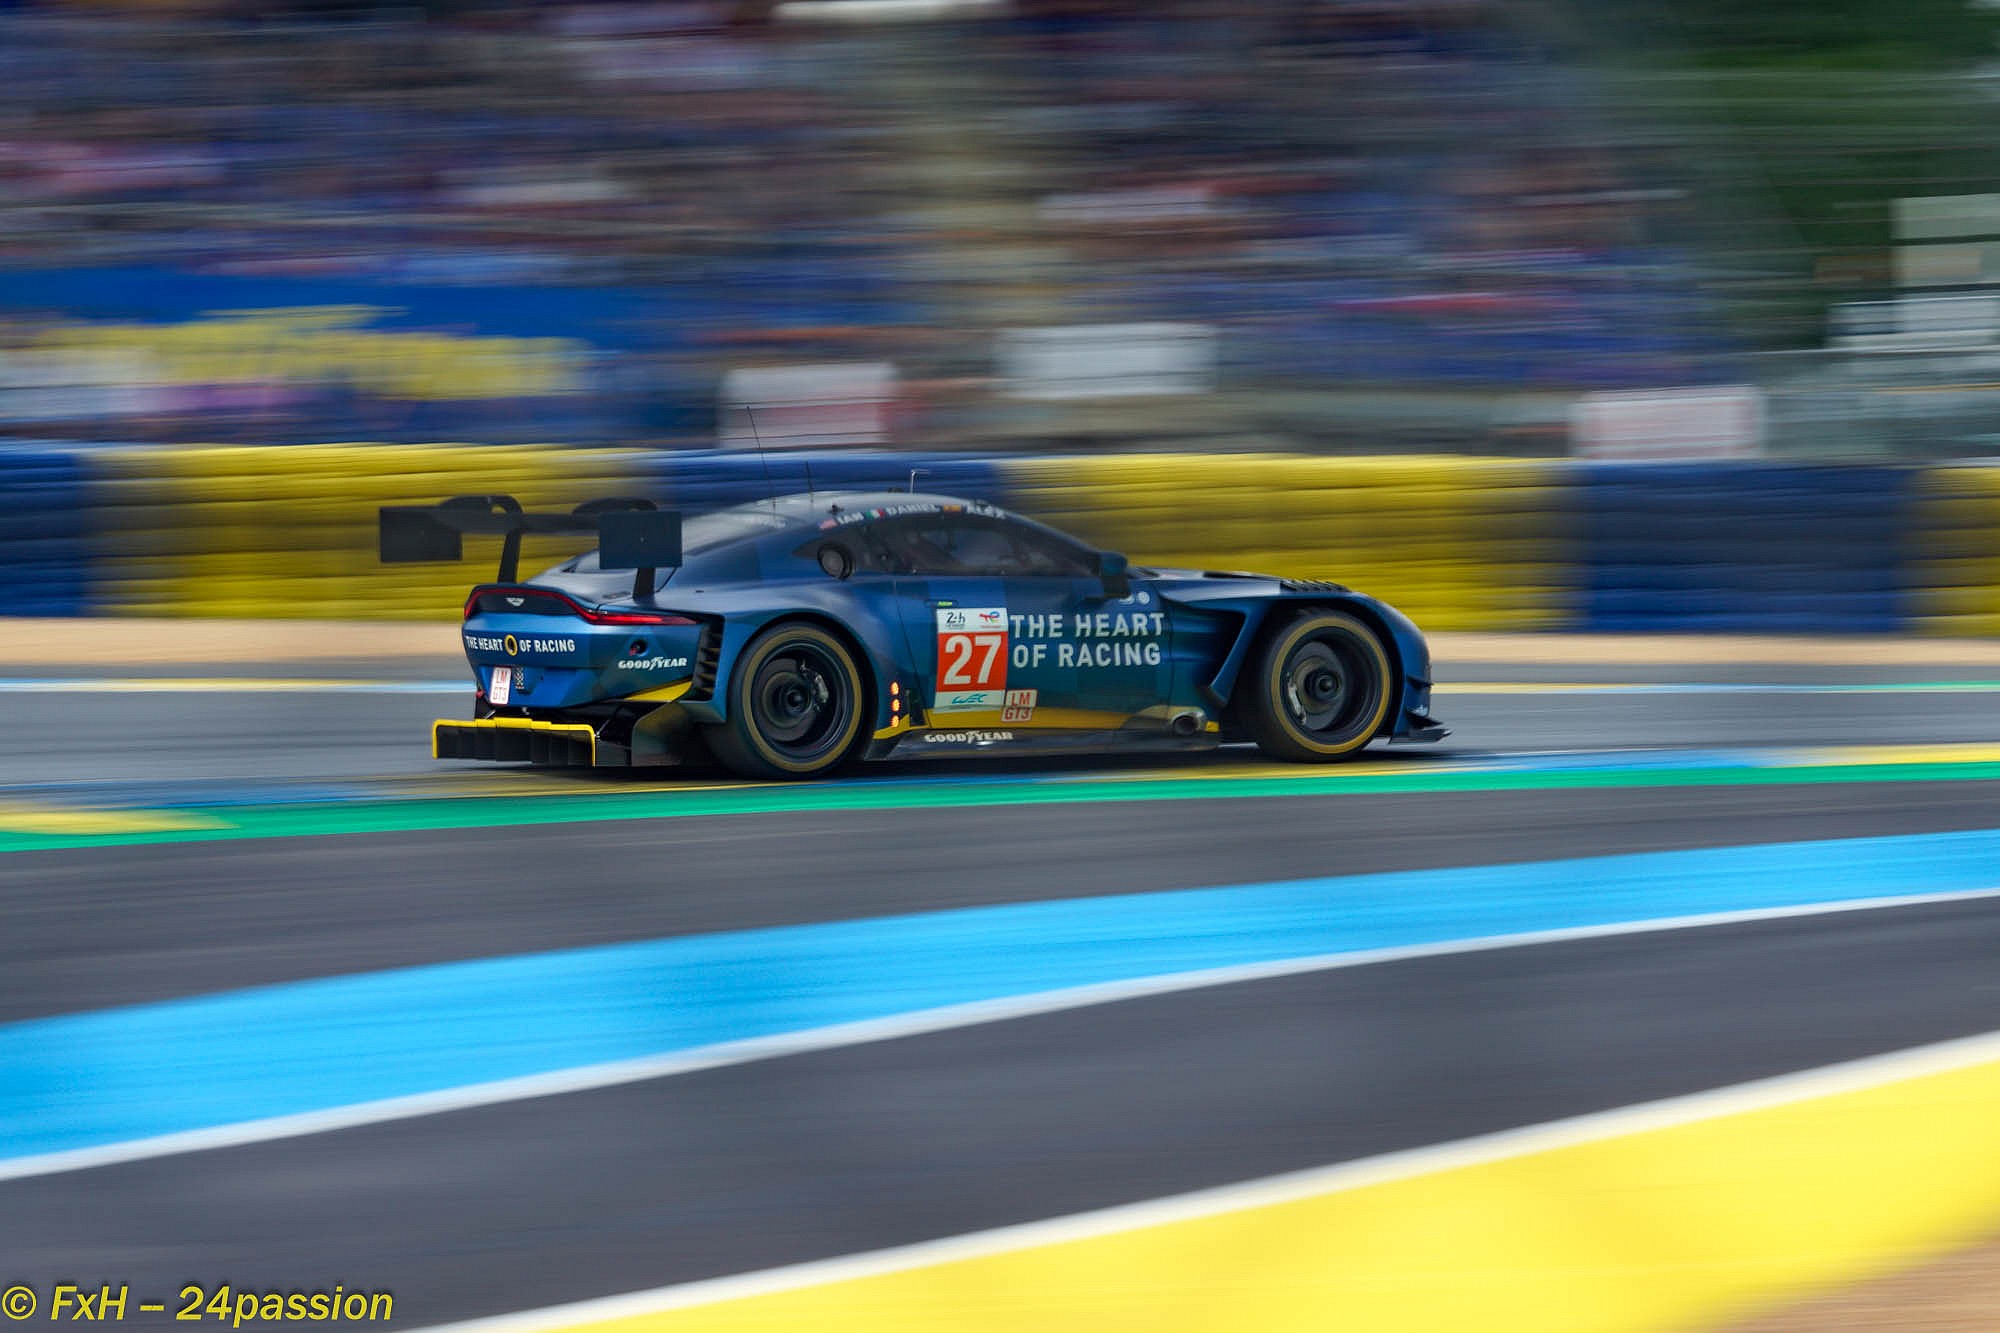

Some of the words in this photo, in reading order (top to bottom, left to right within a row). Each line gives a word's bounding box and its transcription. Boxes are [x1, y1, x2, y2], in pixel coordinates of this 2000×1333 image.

[886, 503, 940, 516] DANIEL
[1010, 614, 1064, 639] THE
[1076, 612, 1165, 637] HEART
[465, 636, 478, 650] THE
[479, 638, 503, 651] HEART
[520, 639, 531, 652] OF
[534, 639, 576, 653] RACING
[943, 634, 1002, 685] 27
[1013, 644, 1047, 668] OF
[1058, 641, 1161, 667] RACING
[618, 656, 688, 671] GOODYEAR
[496, 669, 508, 684] LM
[951, 693, 988, 705] WEC
[1011, 691, 1031, 707] LM
[1005, 707, 1030, 721] GT3
[924, 730, 1014, 745] GOODYEAR
